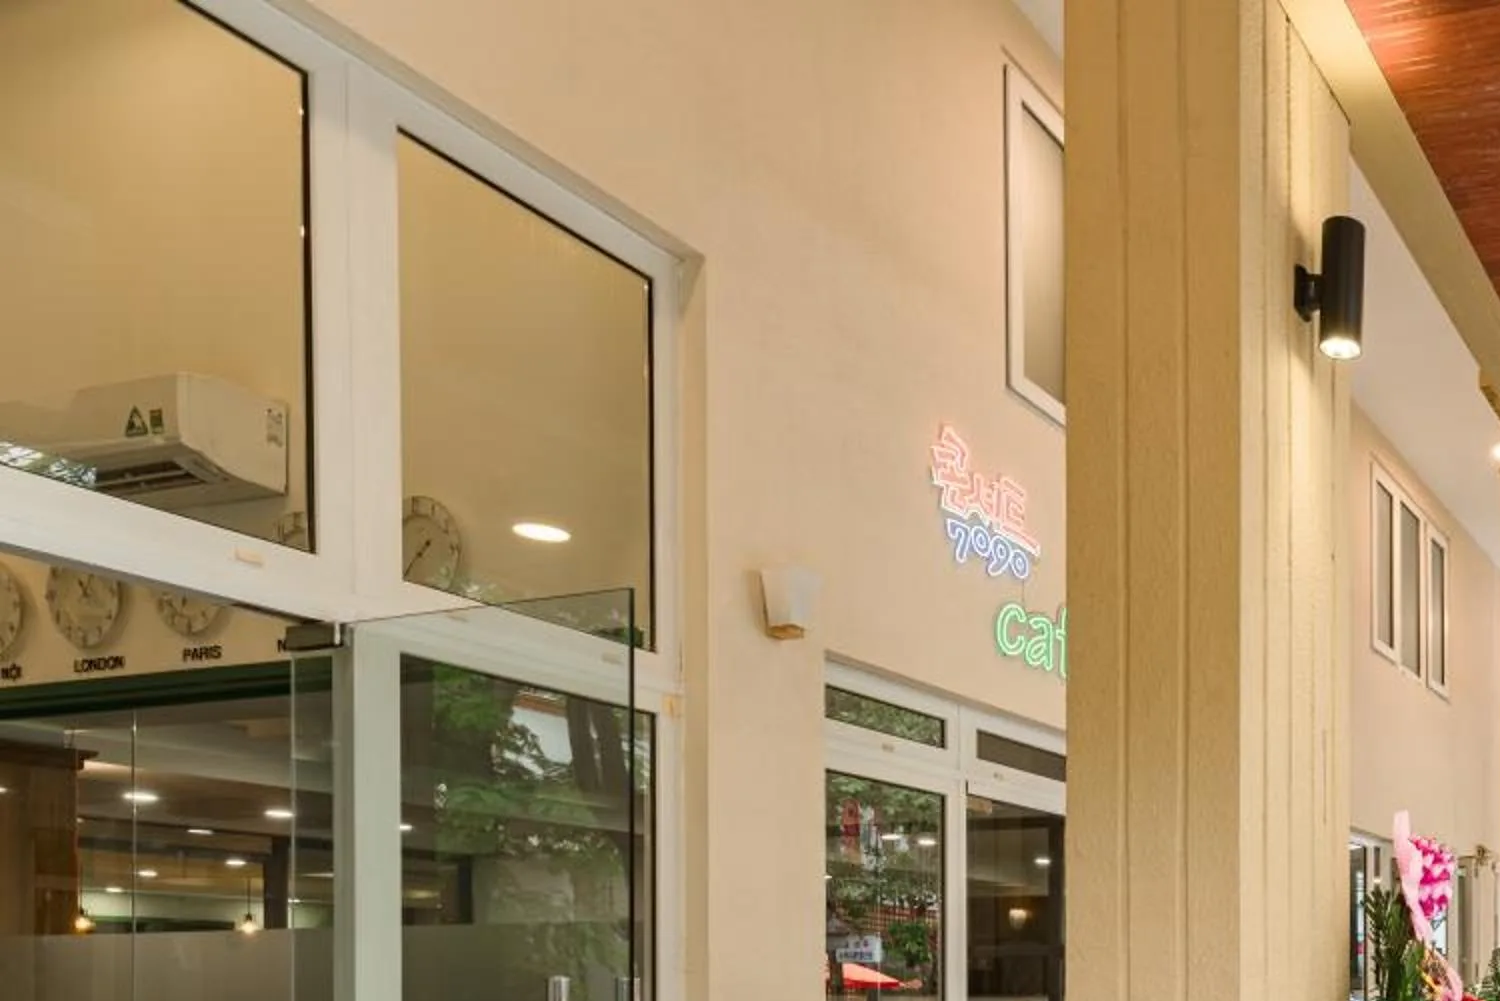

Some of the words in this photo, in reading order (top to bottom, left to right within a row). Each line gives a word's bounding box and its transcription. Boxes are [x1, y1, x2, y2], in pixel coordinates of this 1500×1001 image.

[947, 518, 1029, 579] 7090
[182, 645, 223, 663] PARIS
[73, 655, 125, 673] LONDON
